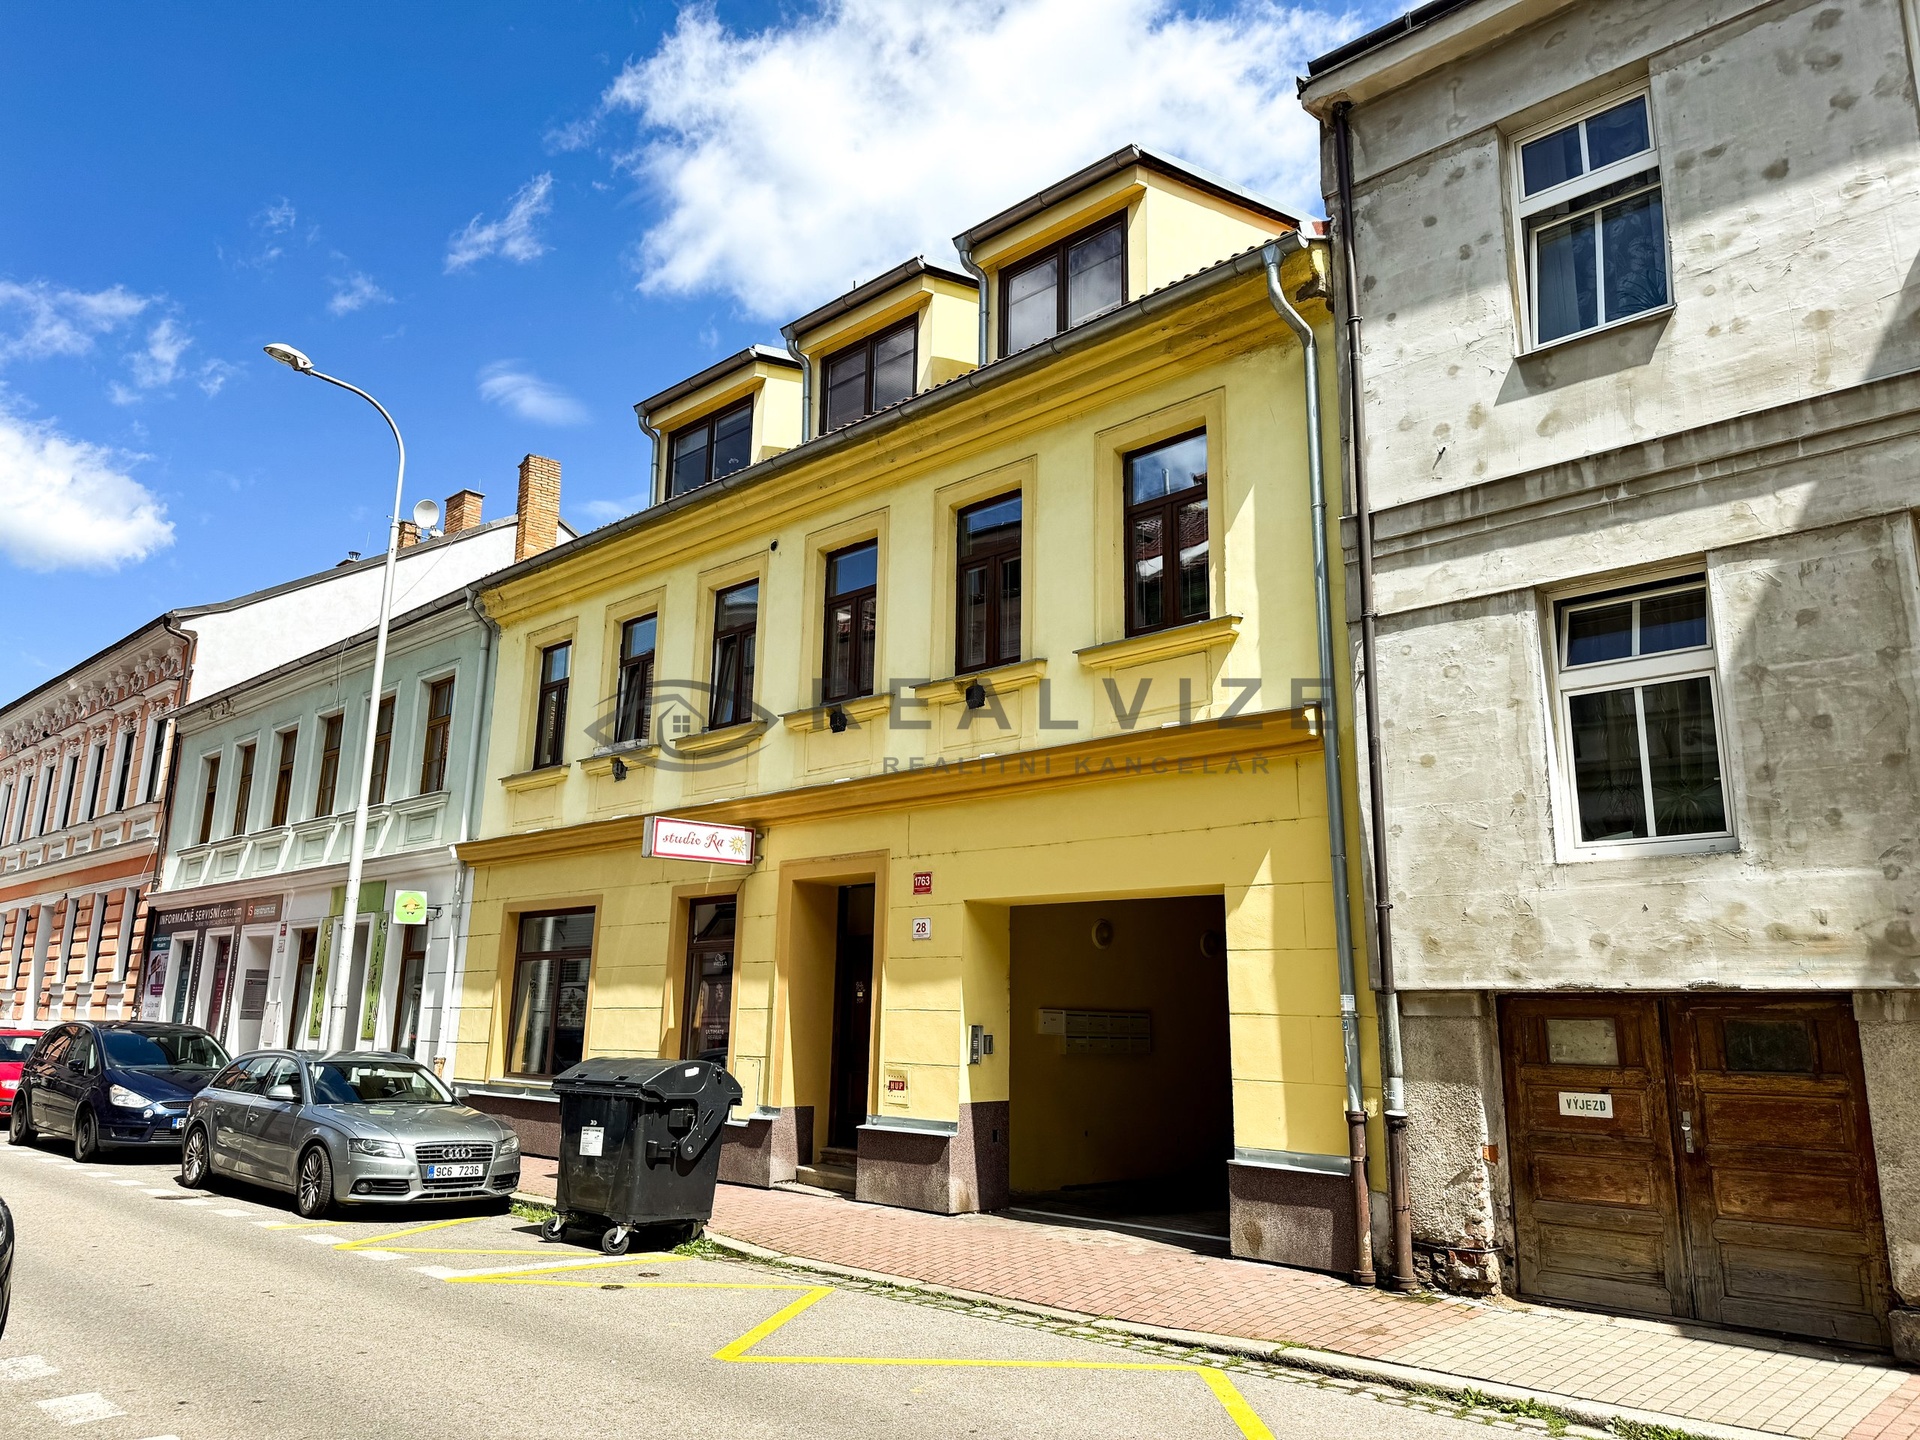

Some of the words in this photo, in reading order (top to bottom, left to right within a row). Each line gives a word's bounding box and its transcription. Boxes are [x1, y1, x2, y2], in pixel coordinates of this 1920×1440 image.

[662, 831, 702, 846] studio
[703, 831, 725, 854] Ra
[914, 876, 930, 886] 1763
[915, 922, 927, 933] 28
[890, 1081, 904, 1090] HUP
[1566, 1095, 1606, 1112] VÝJEZD
[436, 1166, 453, 1177] 9C6
[458, 1165, 480, 1176] 7236
